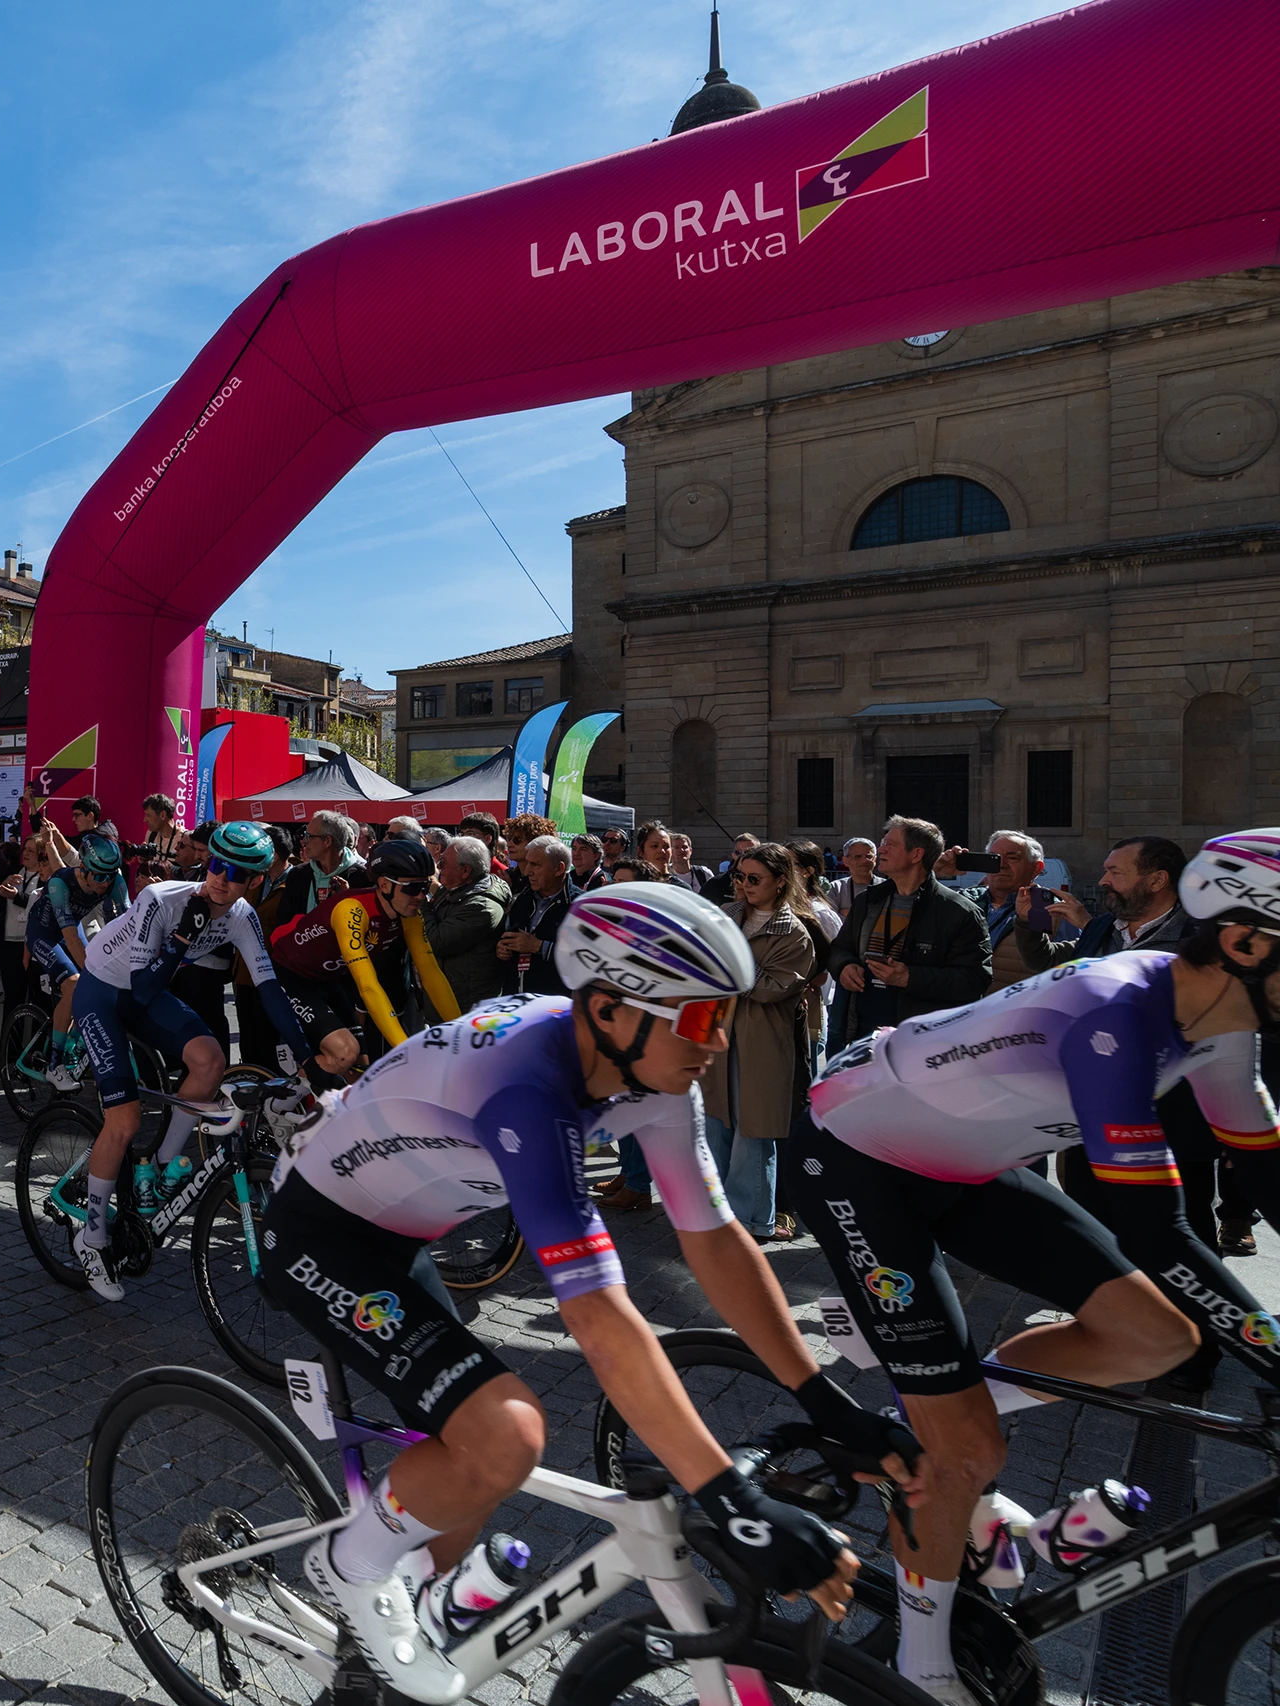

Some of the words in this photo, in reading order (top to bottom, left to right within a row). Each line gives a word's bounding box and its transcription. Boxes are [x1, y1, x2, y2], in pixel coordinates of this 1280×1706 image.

[530, 181, 784, 278] LABORAL
[675, 232, 787, 280] kutxa
[114, 476, 156, 521] banka
[176, 758, 188, 827] BORAL
[187, 759, 195, 801] kutxa
[102, 915, 137, 955] OMNIYAT
[138, 899, 159, 944] Bianchi
[294, 923, 328, 946] Cofidis
[348, 906, 364, 951] Cofidis
[78, 1012, 116, 1075] friendly
[93, 1018, 114, 1048] BUSINESS
[277, 1048, 288, 1062] 121
[1109, 1127, 1166, 1139] FACTO
[566, 1127, 586, 1195] CORTIZO
[151, 1144, 227, 1237] Bianchi
[821, 1305, 854, 1337] 103
[287, 1367, 313, 1404] 102
[887, 1360, 961, 1377] vision
[1075, 1522, 1220, 1613] BH
[494, 1560, 600, 1660] BH
[248, 1632, 306, 1661] BH
